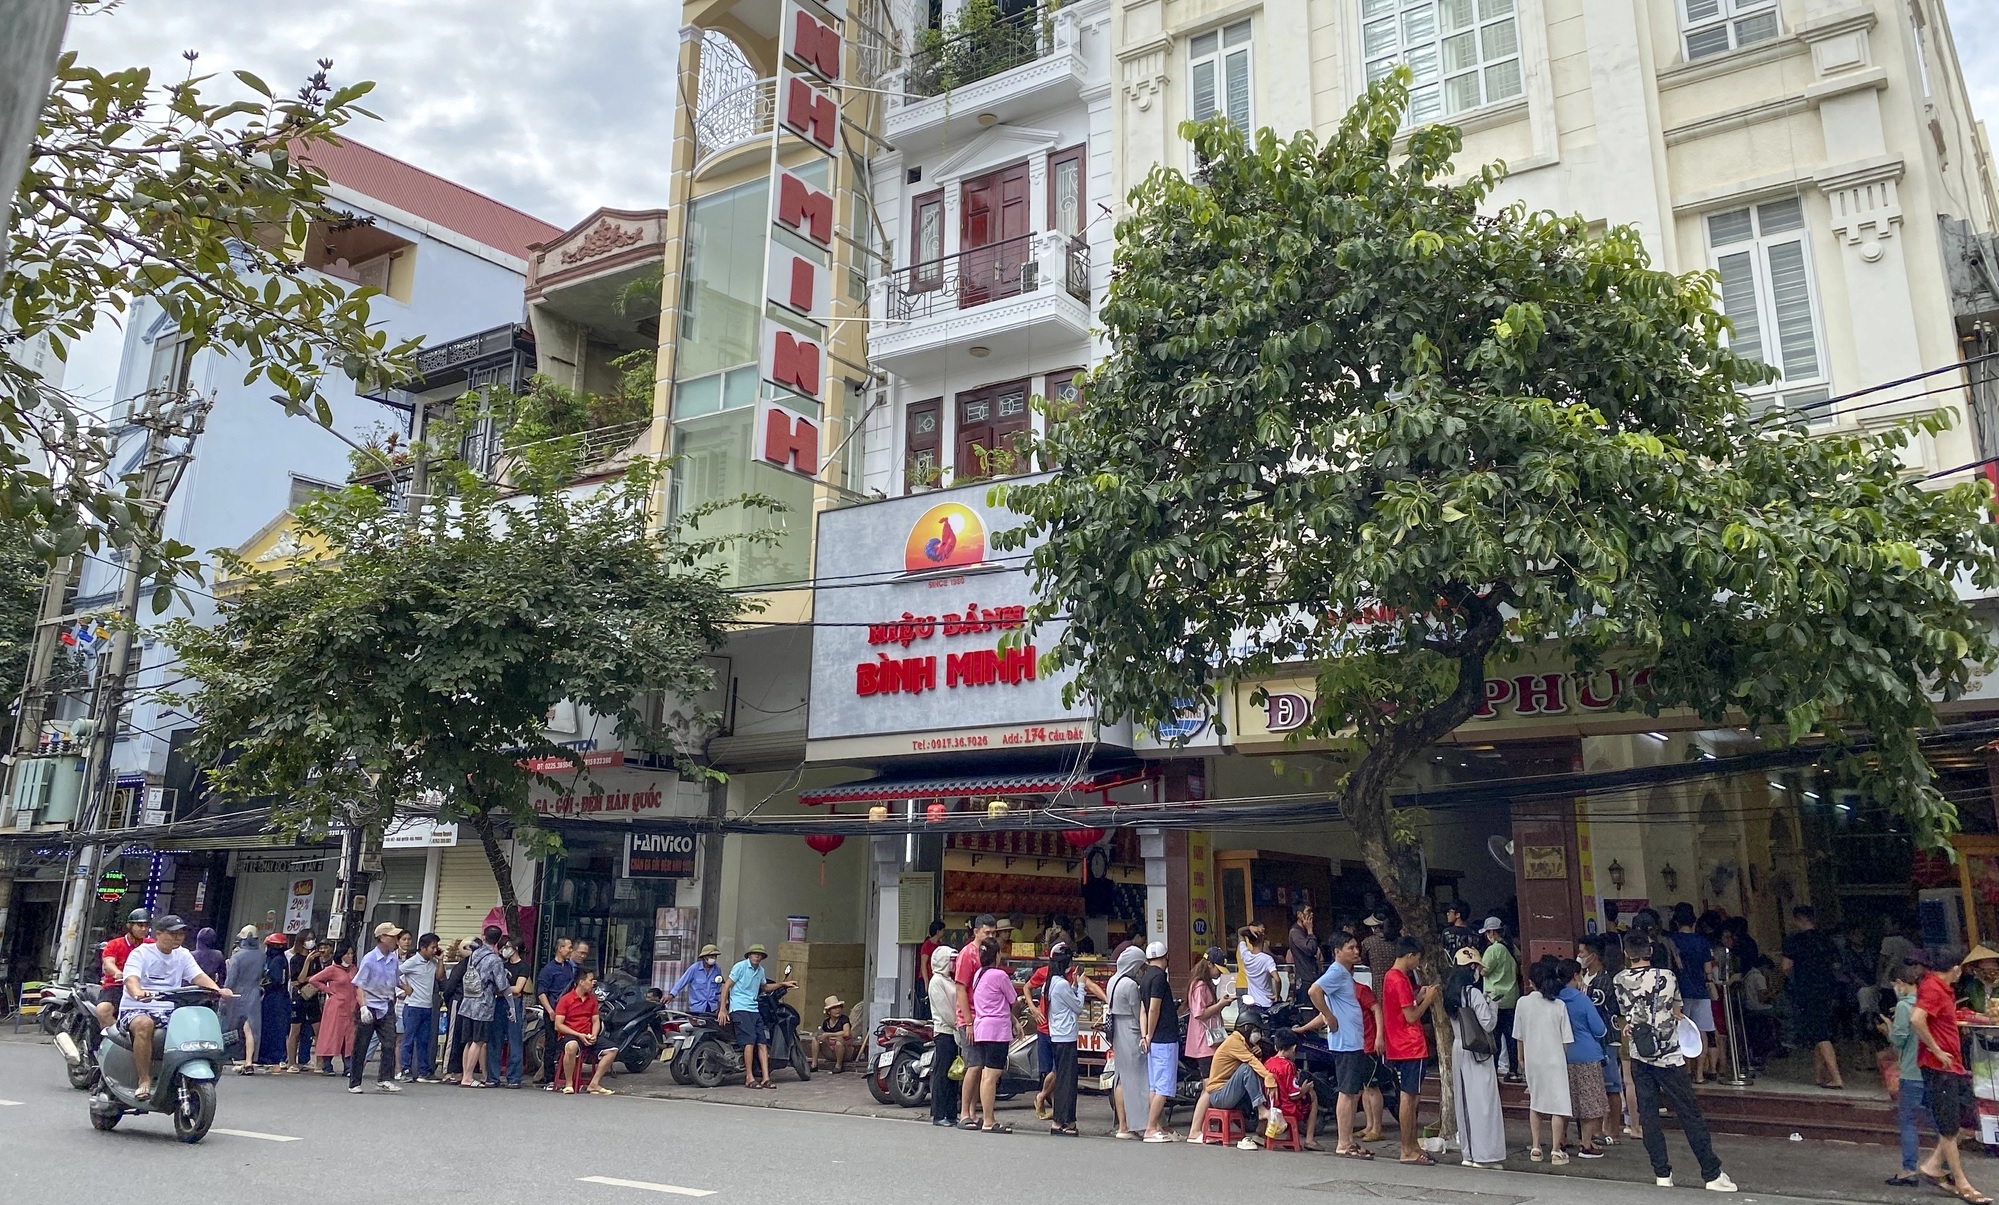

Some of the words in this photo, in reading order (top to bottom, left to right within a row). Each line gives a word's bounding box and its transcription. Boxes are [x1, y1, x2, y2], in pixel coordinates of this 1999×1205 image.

[765, 173, 834, 476] MINH
[927, 579, 948, 588] SINCE
[868, 611, 936, 648] HIỆU
[942, 602, 1026, 636] BÁNH
[856, 652, 936, 696] BÌNH
[946, 645, 1037, 688] MINH
[1024, 727, 1046, 743] 174
[534, 799, 548, 813] GA
[632, 783, 663, 813] QUỐC
[290, 898, 310, 911] 20%
[1195, 920, 1206, 933] 172
